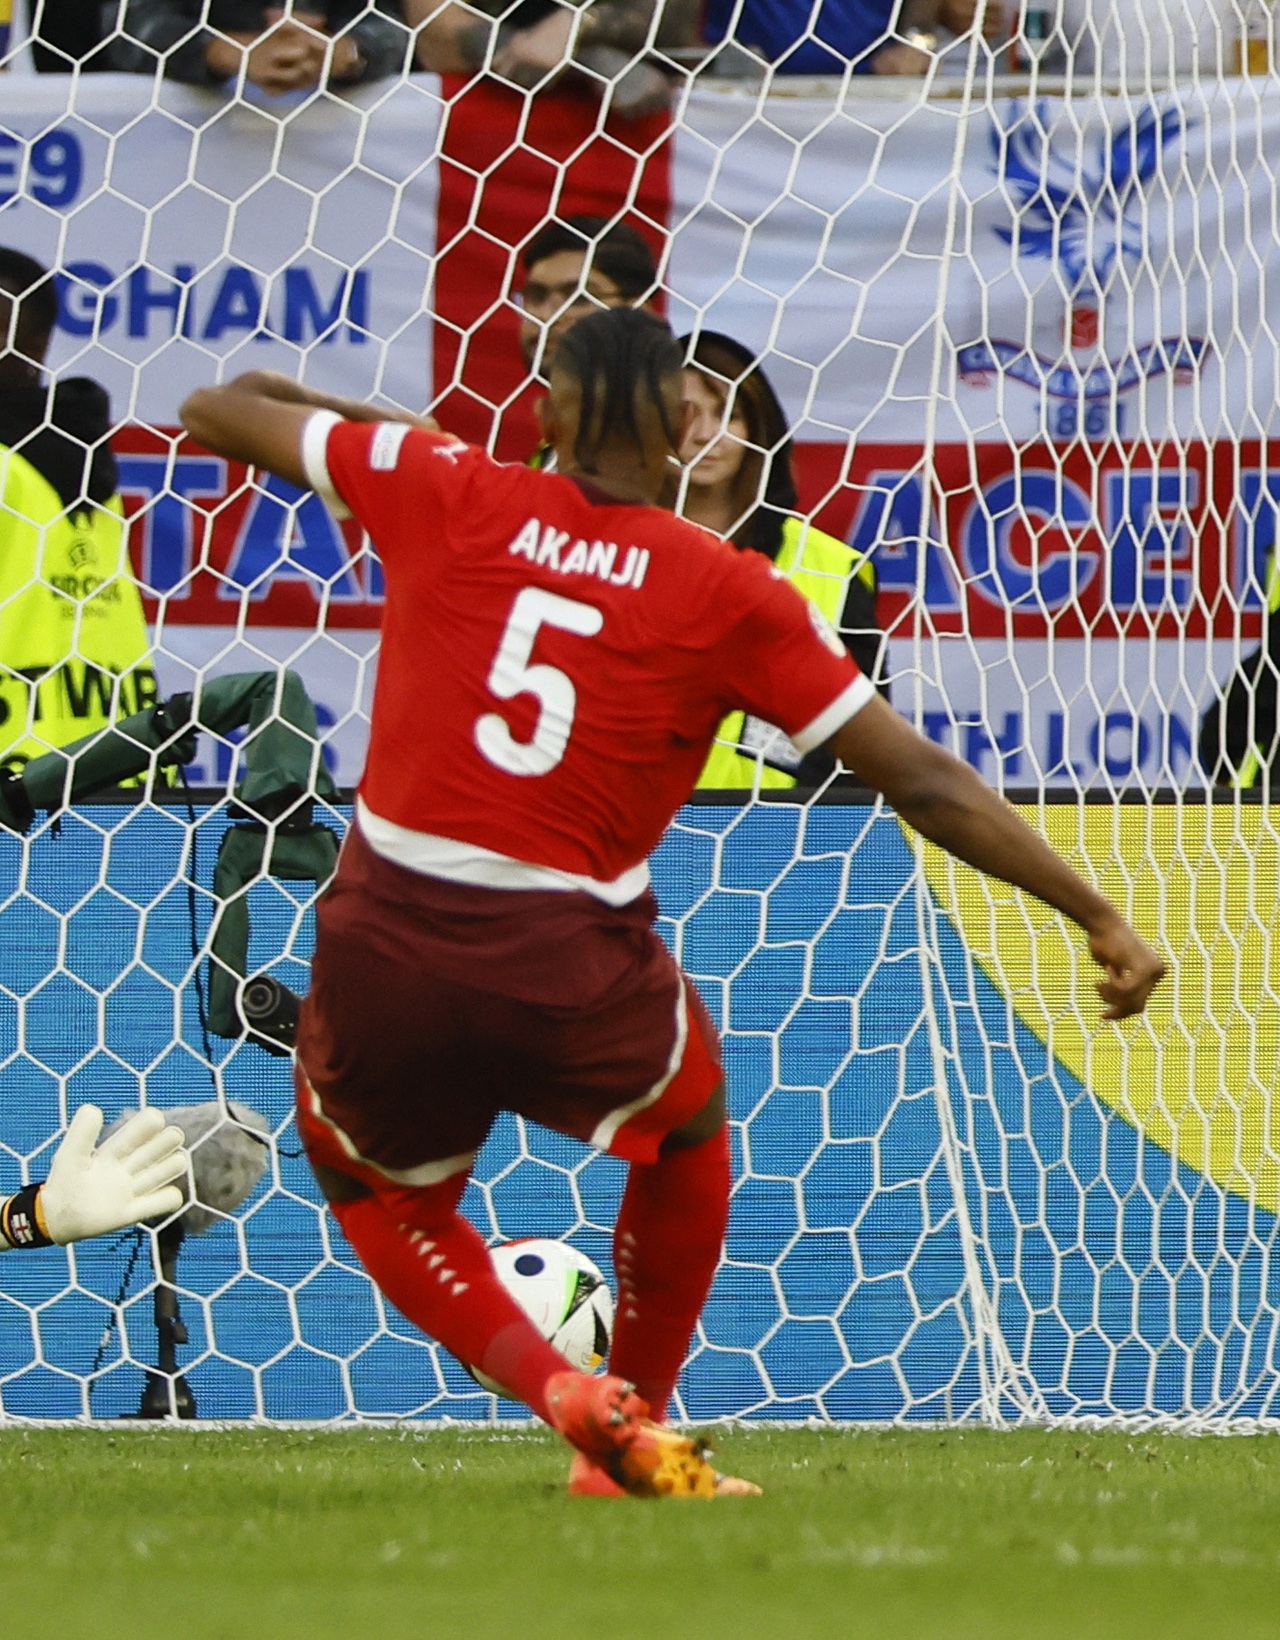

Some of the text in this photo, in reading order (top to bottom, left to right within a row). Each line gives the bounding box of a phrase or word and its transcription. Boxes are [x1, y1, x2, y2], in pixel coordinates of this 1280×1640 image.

[509, 518, 650, 589] AKANJI
[845, 468, 1200, 614] ACE
[474, 586, 604, 776] 5
